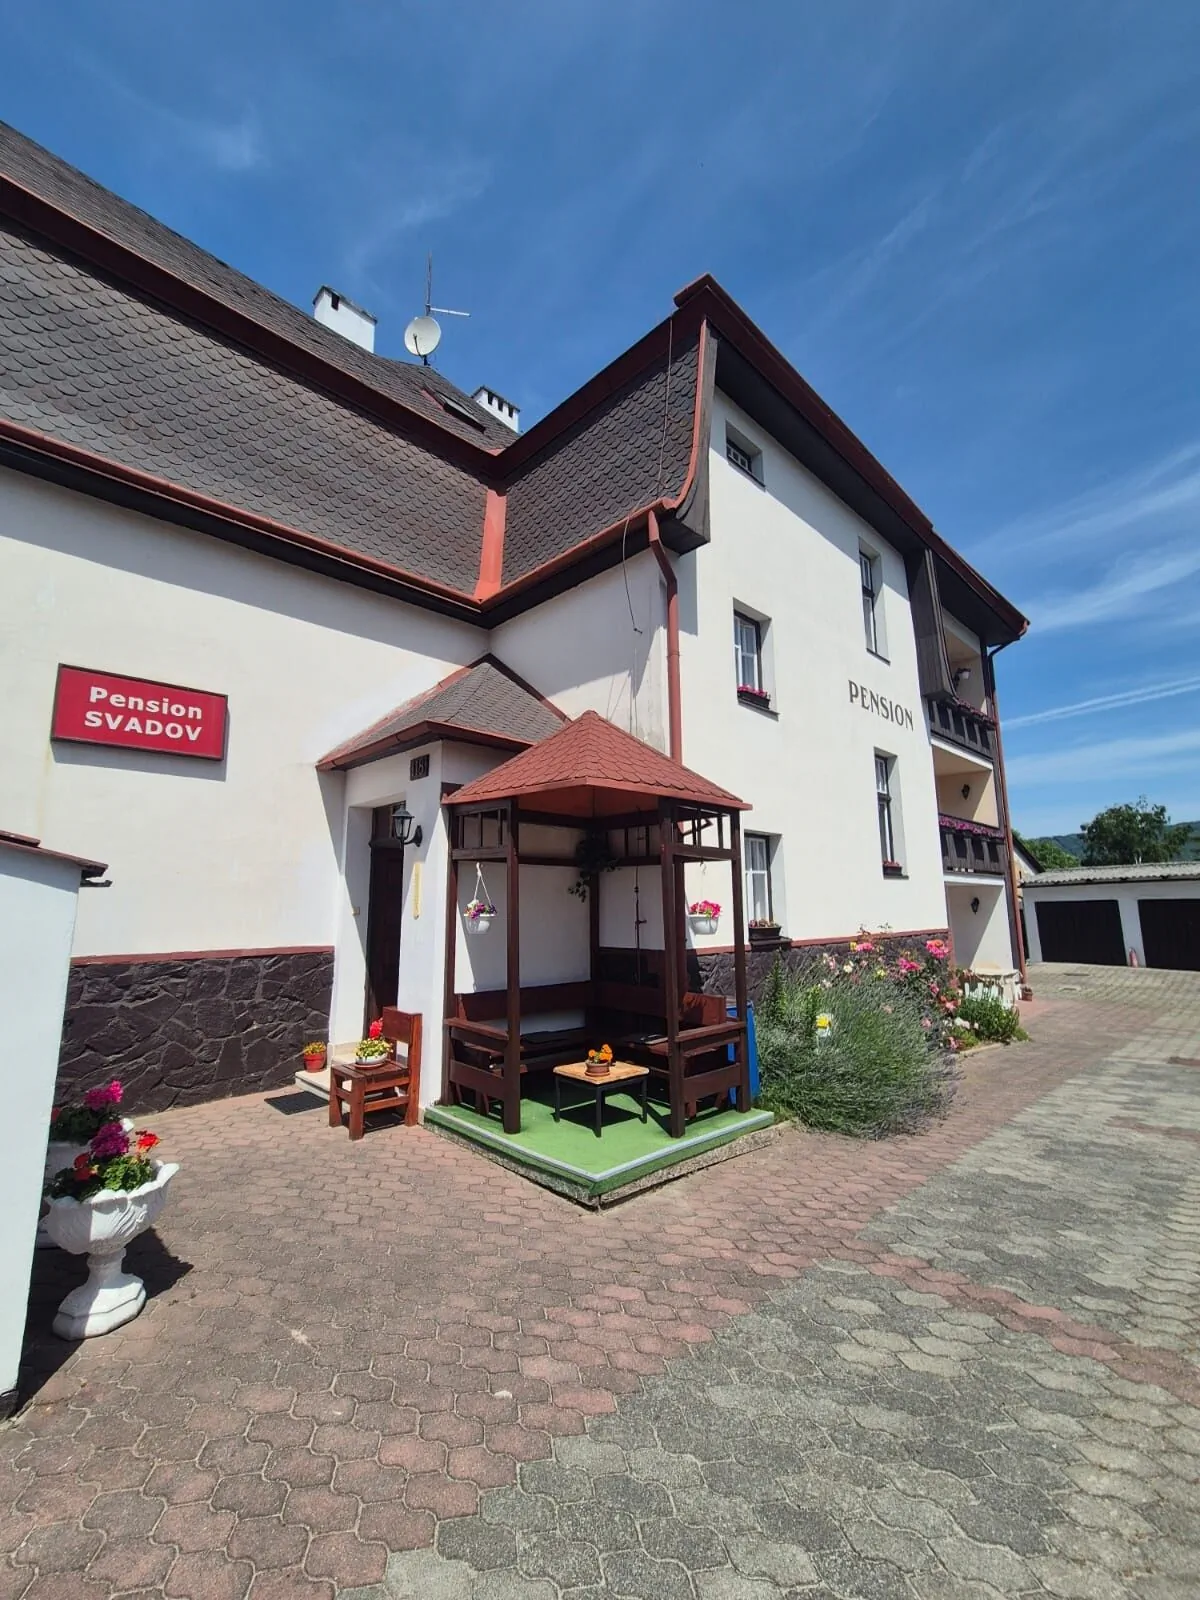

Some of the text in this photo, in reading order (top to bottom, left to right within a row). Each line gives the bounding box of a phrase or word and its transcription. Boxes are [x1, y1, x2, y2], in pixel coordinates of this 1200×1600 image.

[90, 686, 202, 719] Pension
[848, 679, 913, 732] PENSION
[84, 711, 202, 741] SVADOV
